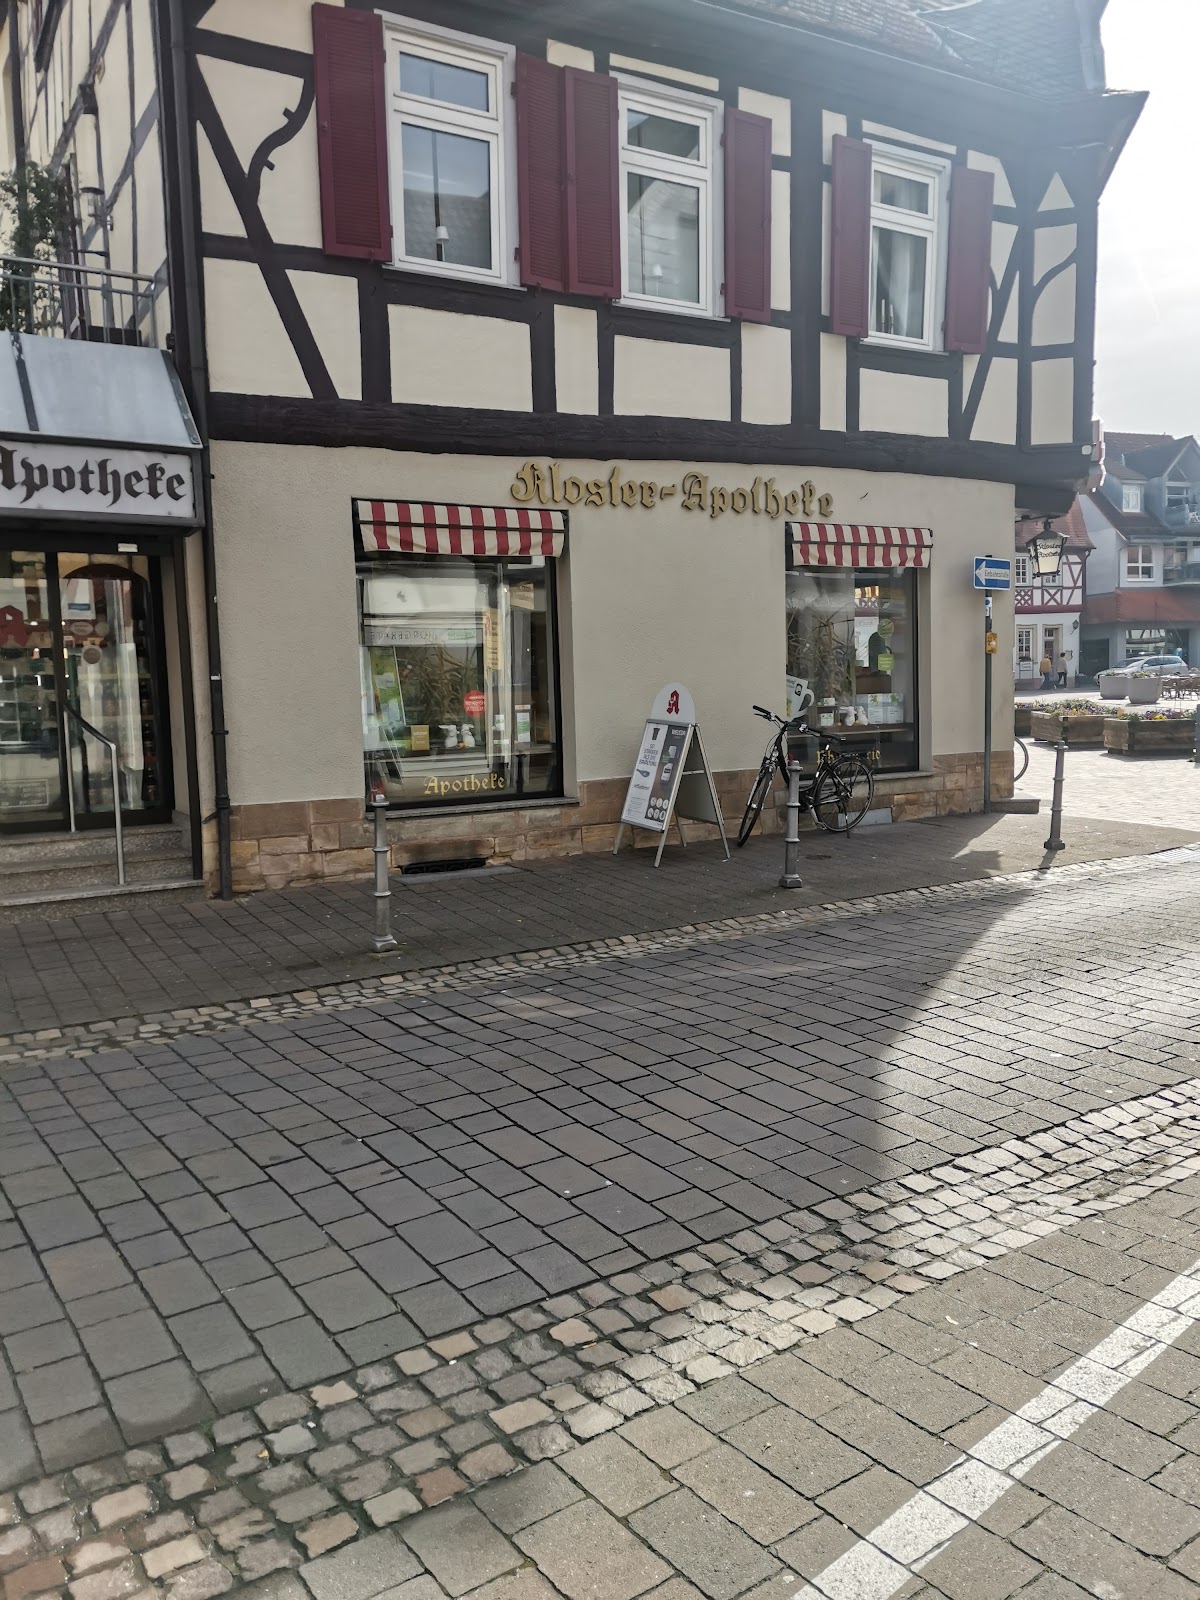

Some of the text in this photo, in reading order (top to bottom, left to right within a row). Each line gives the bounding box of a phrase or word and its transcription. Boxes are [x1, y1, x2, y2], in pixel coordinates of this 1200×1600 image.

[0, 445, 187, 508] Apotheke
[511, 460, 834, 519] Kloster-Apotheke
[423, 772, 506, 796] Apotheke
